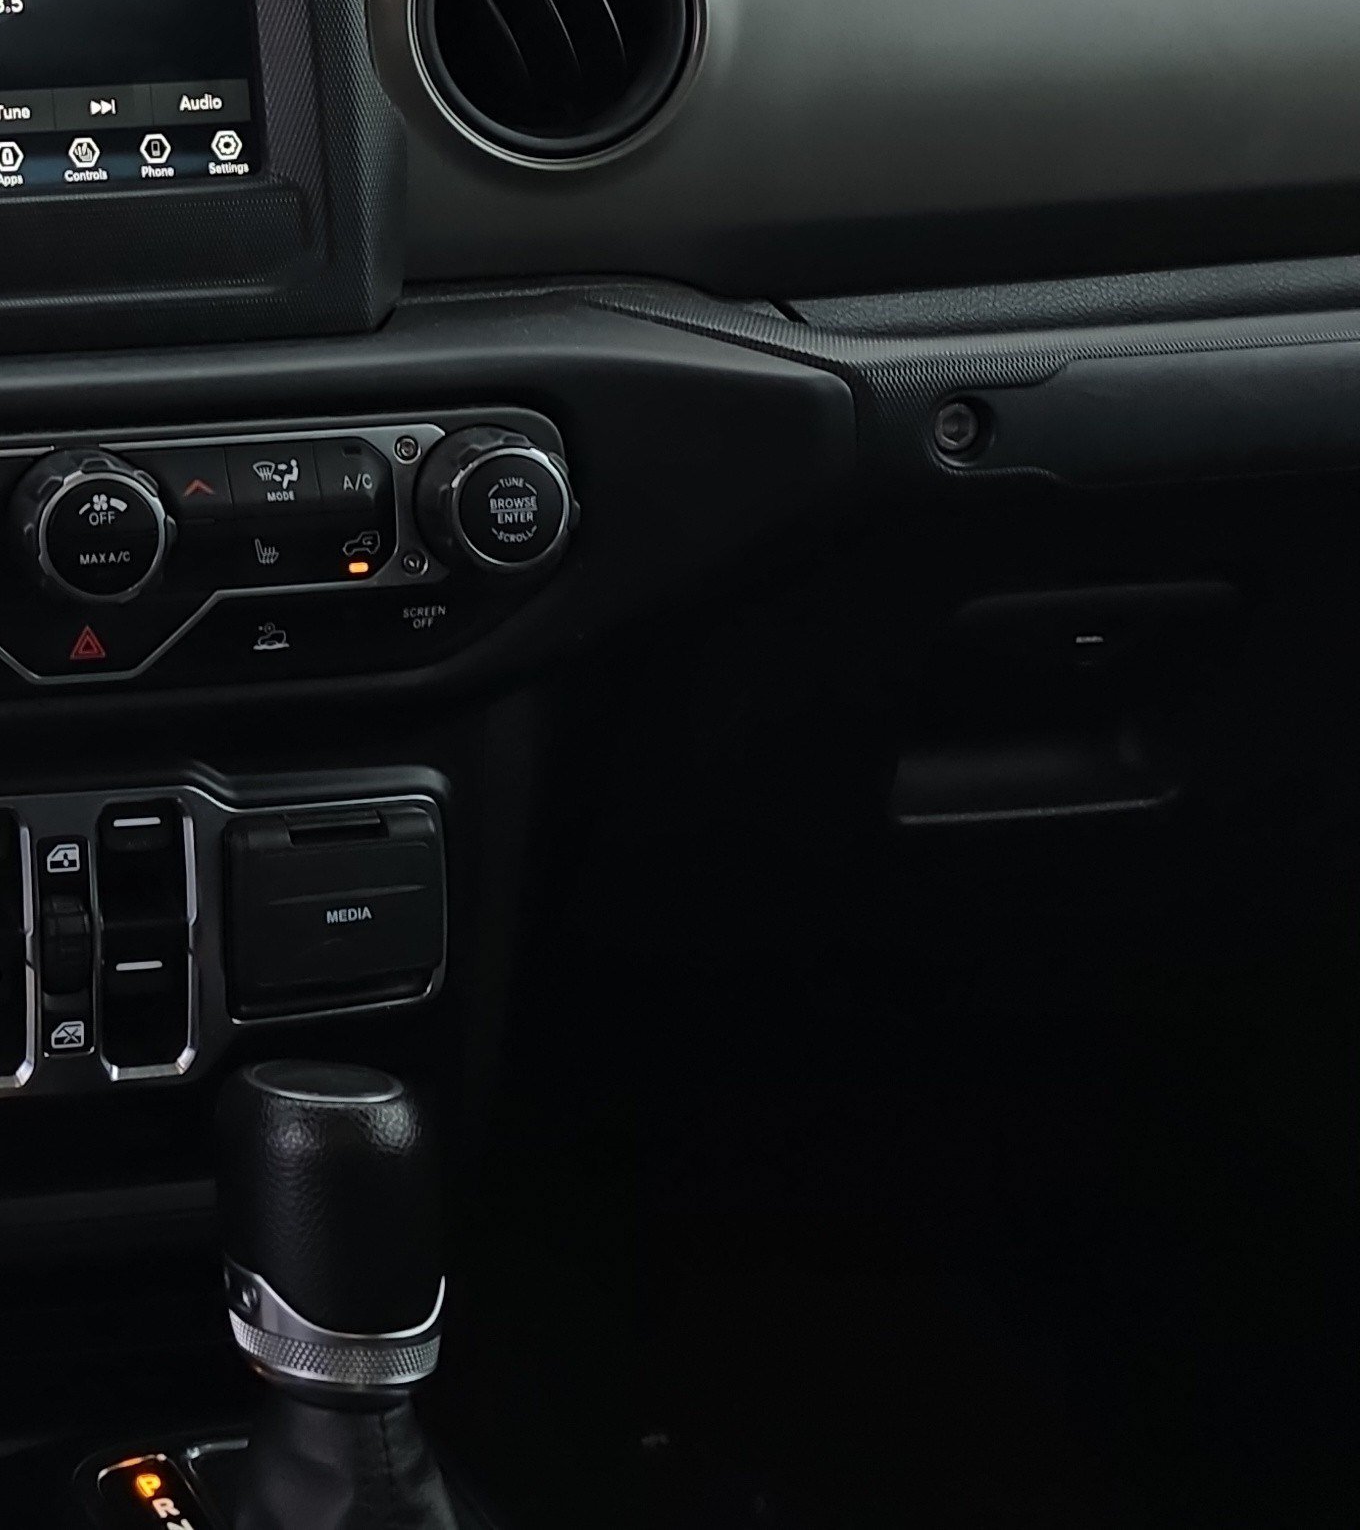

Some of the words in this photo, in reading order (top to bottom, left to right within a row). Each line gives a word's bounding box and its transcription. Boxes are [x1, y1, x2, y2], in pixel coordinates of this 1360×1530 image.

[180, 94, 222, 111] Audio
[141, 165, 174, 178] Phone
[208, 161, 249, 175] Settings
[65, 169, 108, 183] Controls
[342, 474, 374, 492] A/C
[499, 477, 525, 489] TUNE
[266, 490, 295, 502] MODE
[490, 495, 538, 510] BROWSE
[88, 511, 116, 526] OFF
[497, 511, 535, 524] ENTER
[496, 530, 532, 543] SCROLL
[79, 552, 107, 565] MAX
[107, 550, 131, 564] A/C
[402, 605, 446, 619] SCREEN
[413, 617, 435, 629] OFF
[326, 906, 372, 924] MEDIA
[136, 1473, 162, 1498] P
[152, 1497, 181, 1519] R
